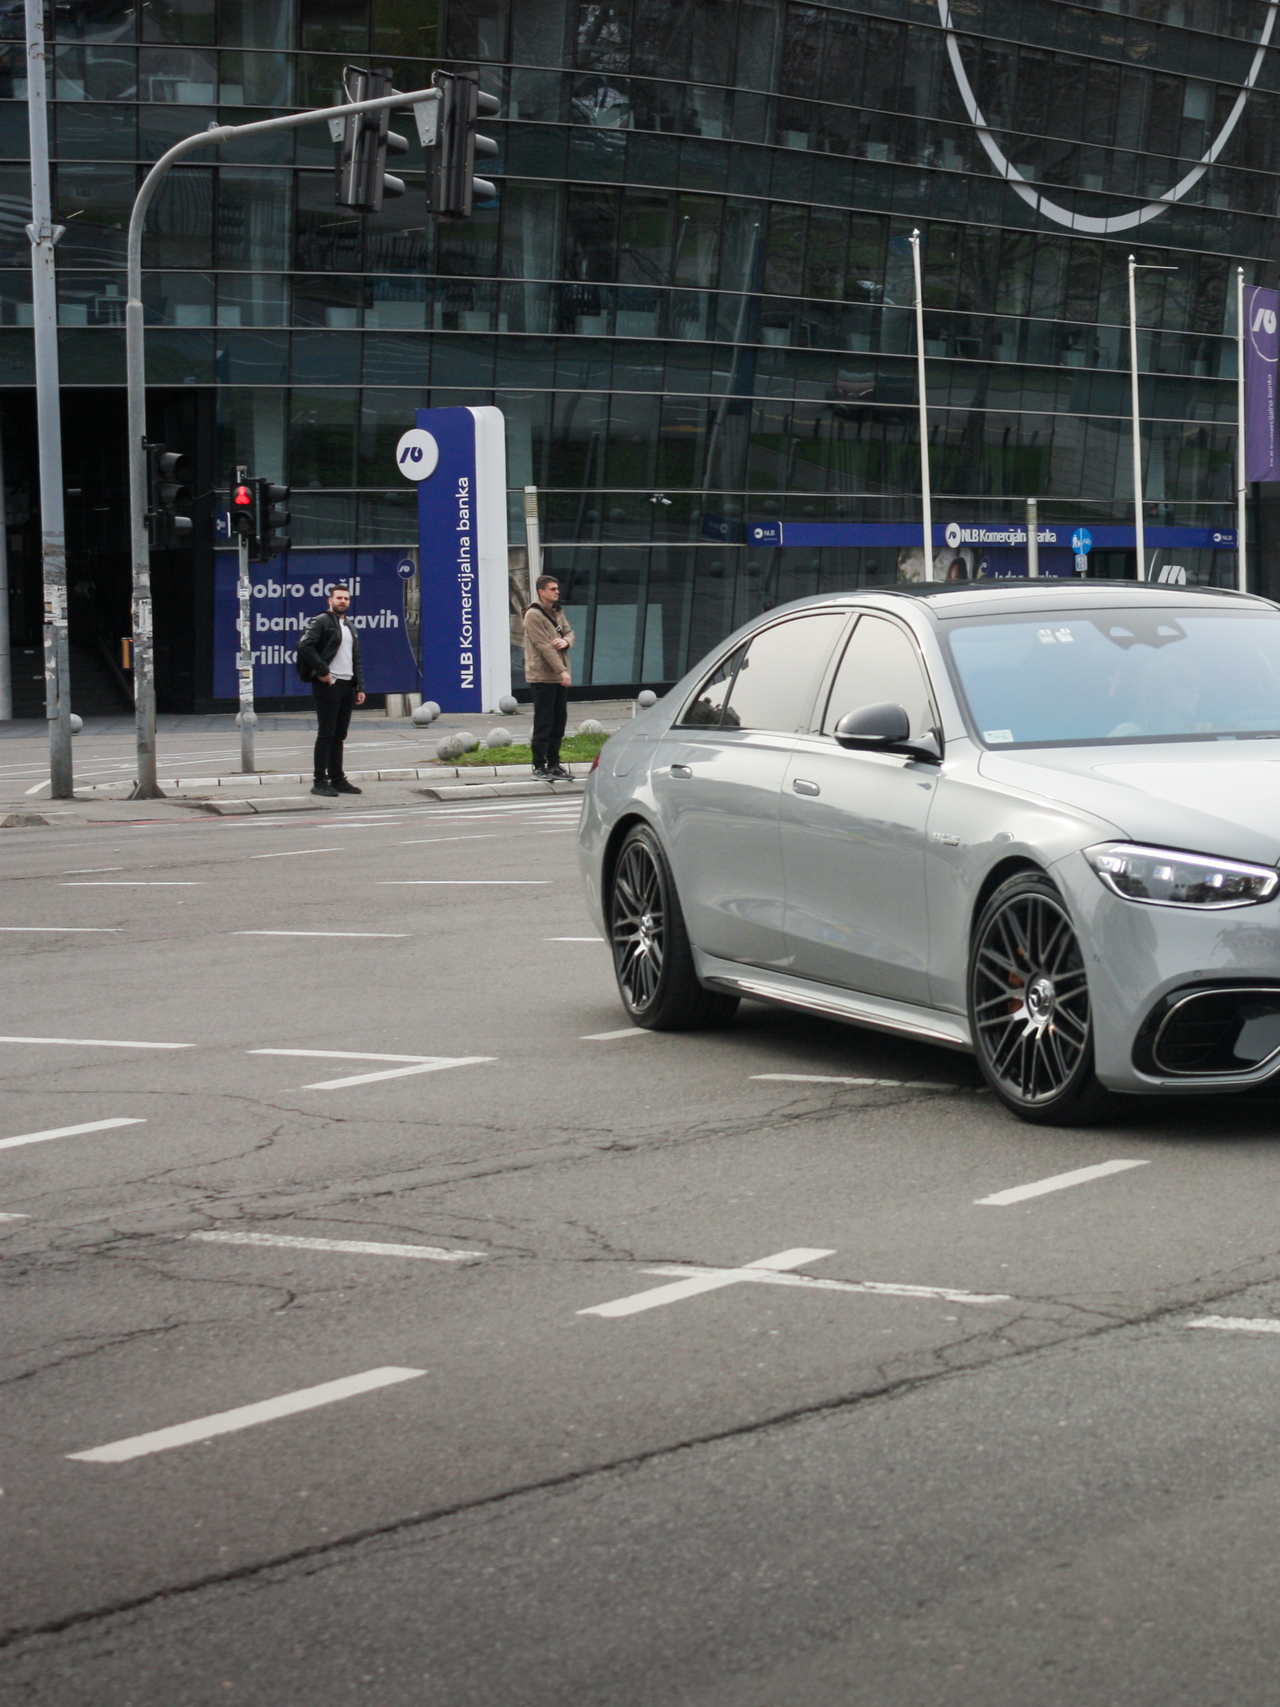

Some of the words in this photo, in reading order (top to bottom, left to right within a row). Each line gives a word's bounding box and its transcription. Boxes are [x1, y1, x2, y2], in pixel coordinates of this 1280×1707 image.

[455, 477, 469, 531] banka
[961, 529, 979, 543] NLB
[1036, 529, 1057, 543] anka
[456, 536, 474, 650] Komercijalna
[256, 612, 312, 632] bank
[460, 652, 474, 689] NLB
